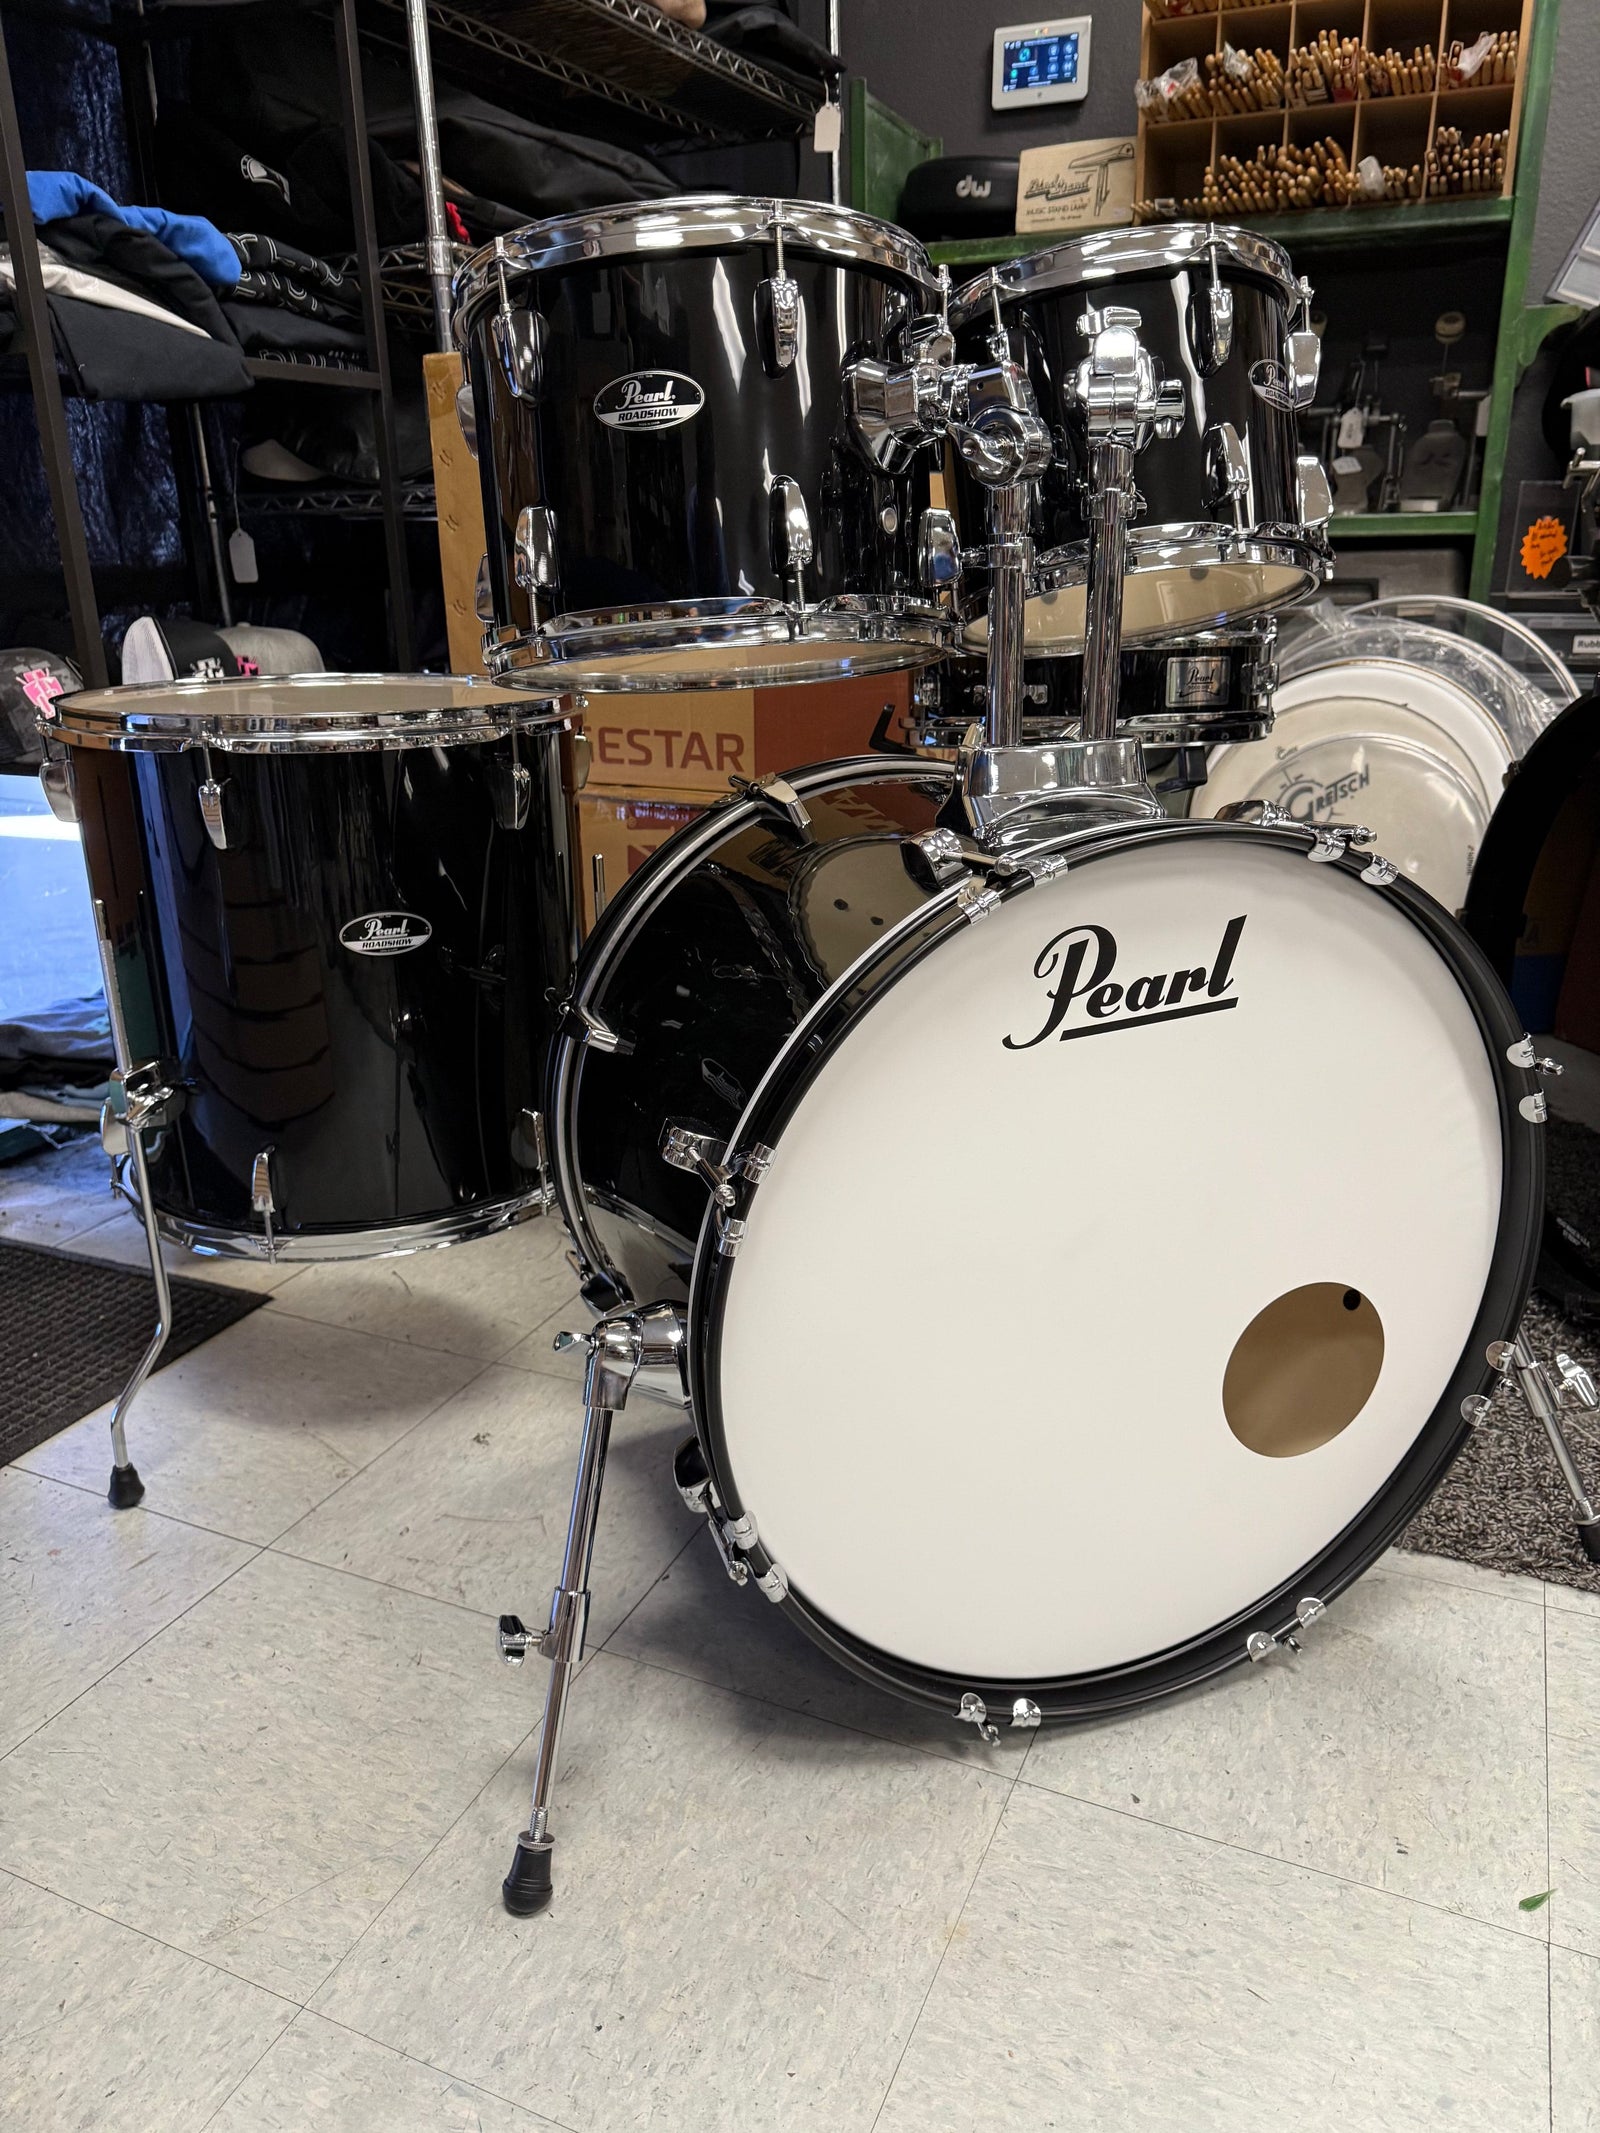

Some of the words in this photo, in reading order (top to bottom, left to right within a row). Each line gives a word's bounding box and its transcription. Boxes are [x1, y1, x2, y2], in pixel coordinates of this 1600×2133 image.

[618, 408, 680, 422] ROADSHOW
[1185, 667, 1216, 686] Pearl
[582, 726, 746, 773] ESTAR
[362, 938, 414, 949] ROADSHOW
[1001, 913, 1248, 1051] Pearl
